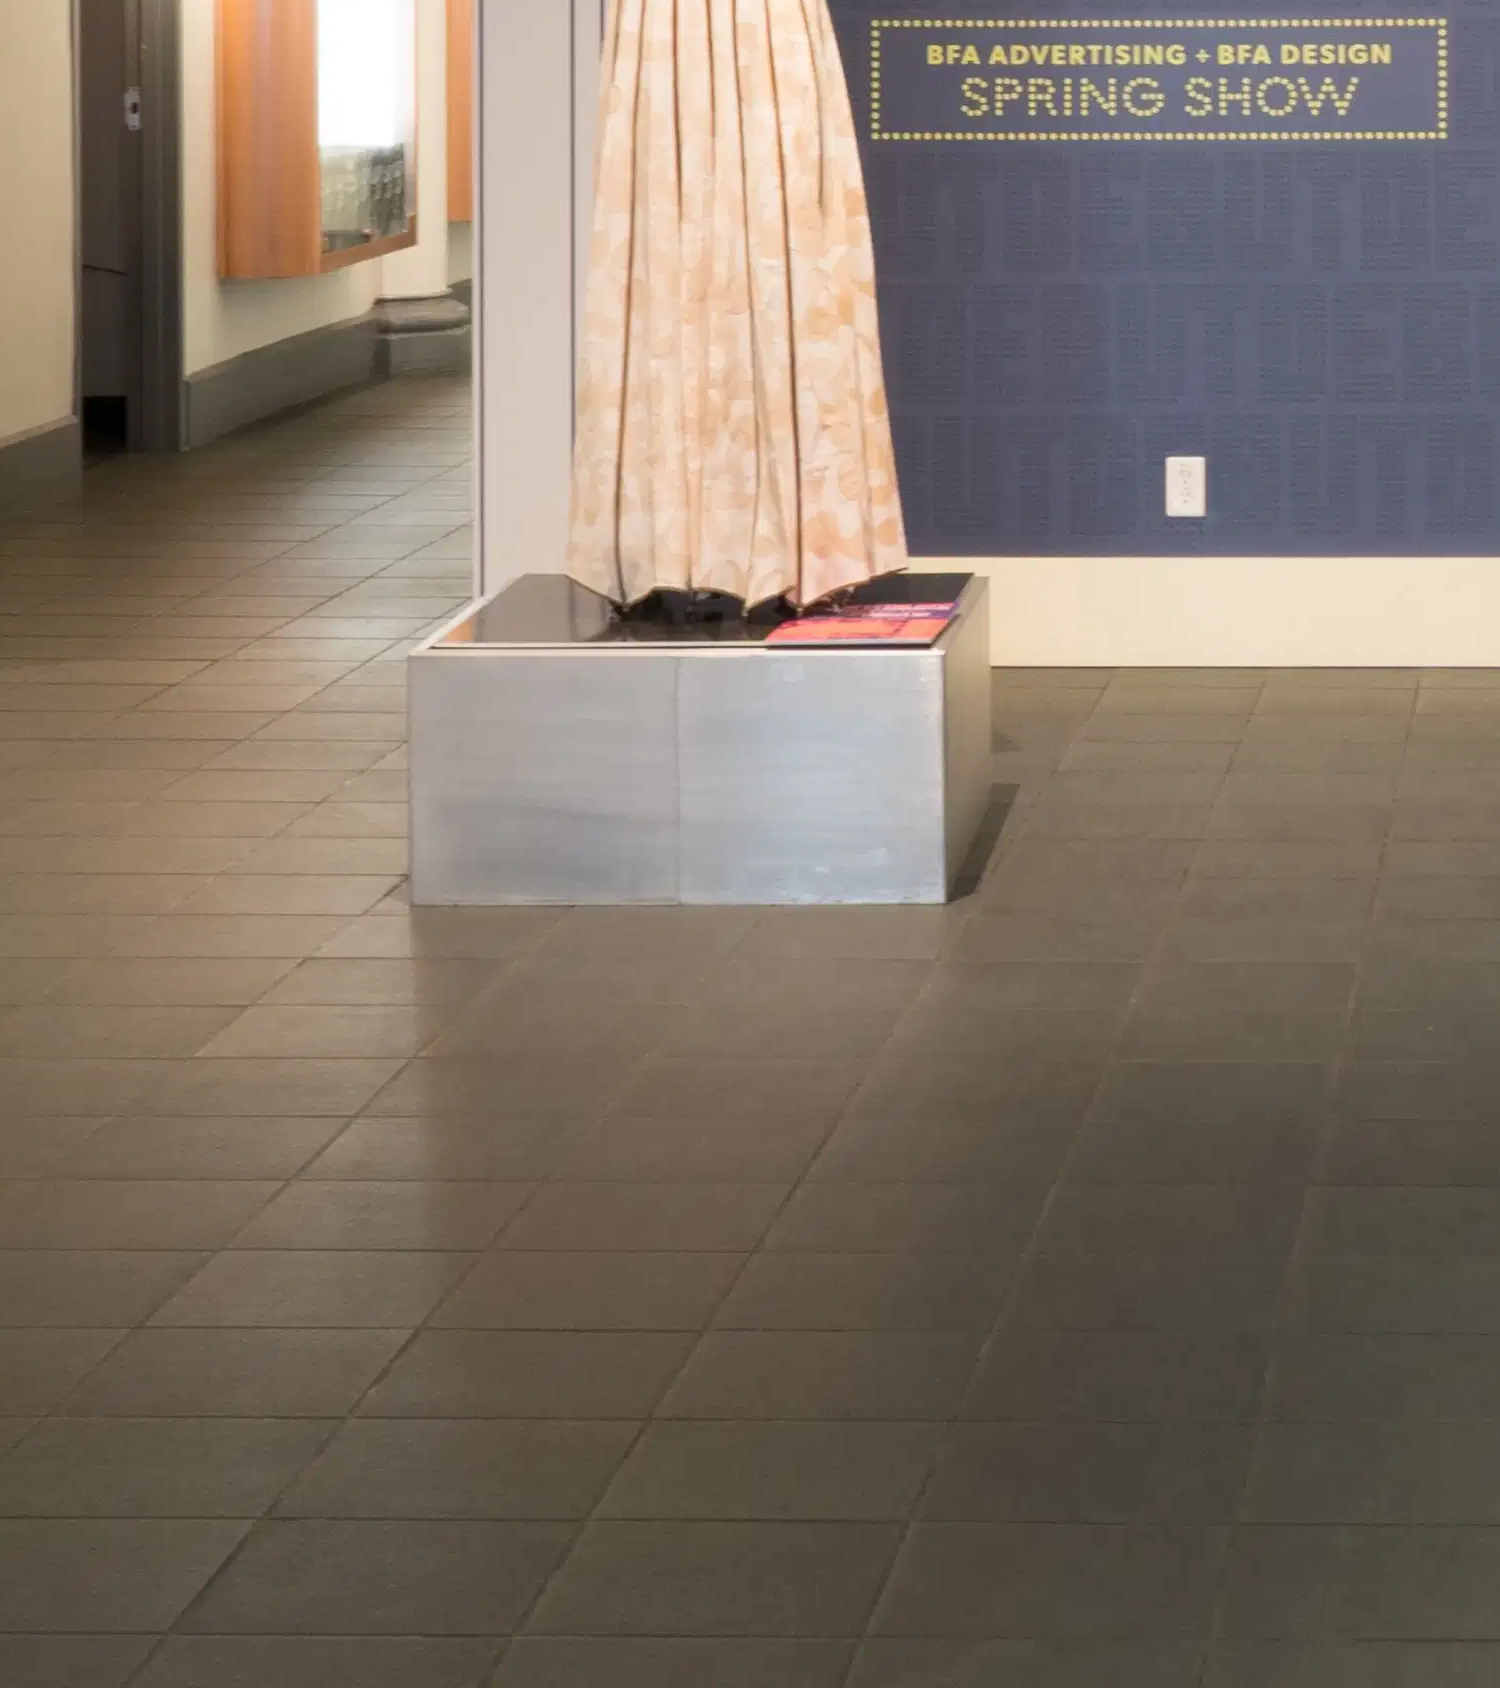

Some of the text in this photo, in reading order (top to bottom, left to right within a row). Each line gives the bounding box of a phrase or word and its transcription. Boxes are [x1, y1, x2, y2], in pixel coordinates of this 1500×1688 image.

[926, 44, 981, 65] BFA
[988, 44, 1187, 65] ADVERTISING
[1218, 44, 1271, 65] BFA
[1280, 43, 1392, 65] DESIGN
[961, 76, 1359, 116] SPRING SHOW
